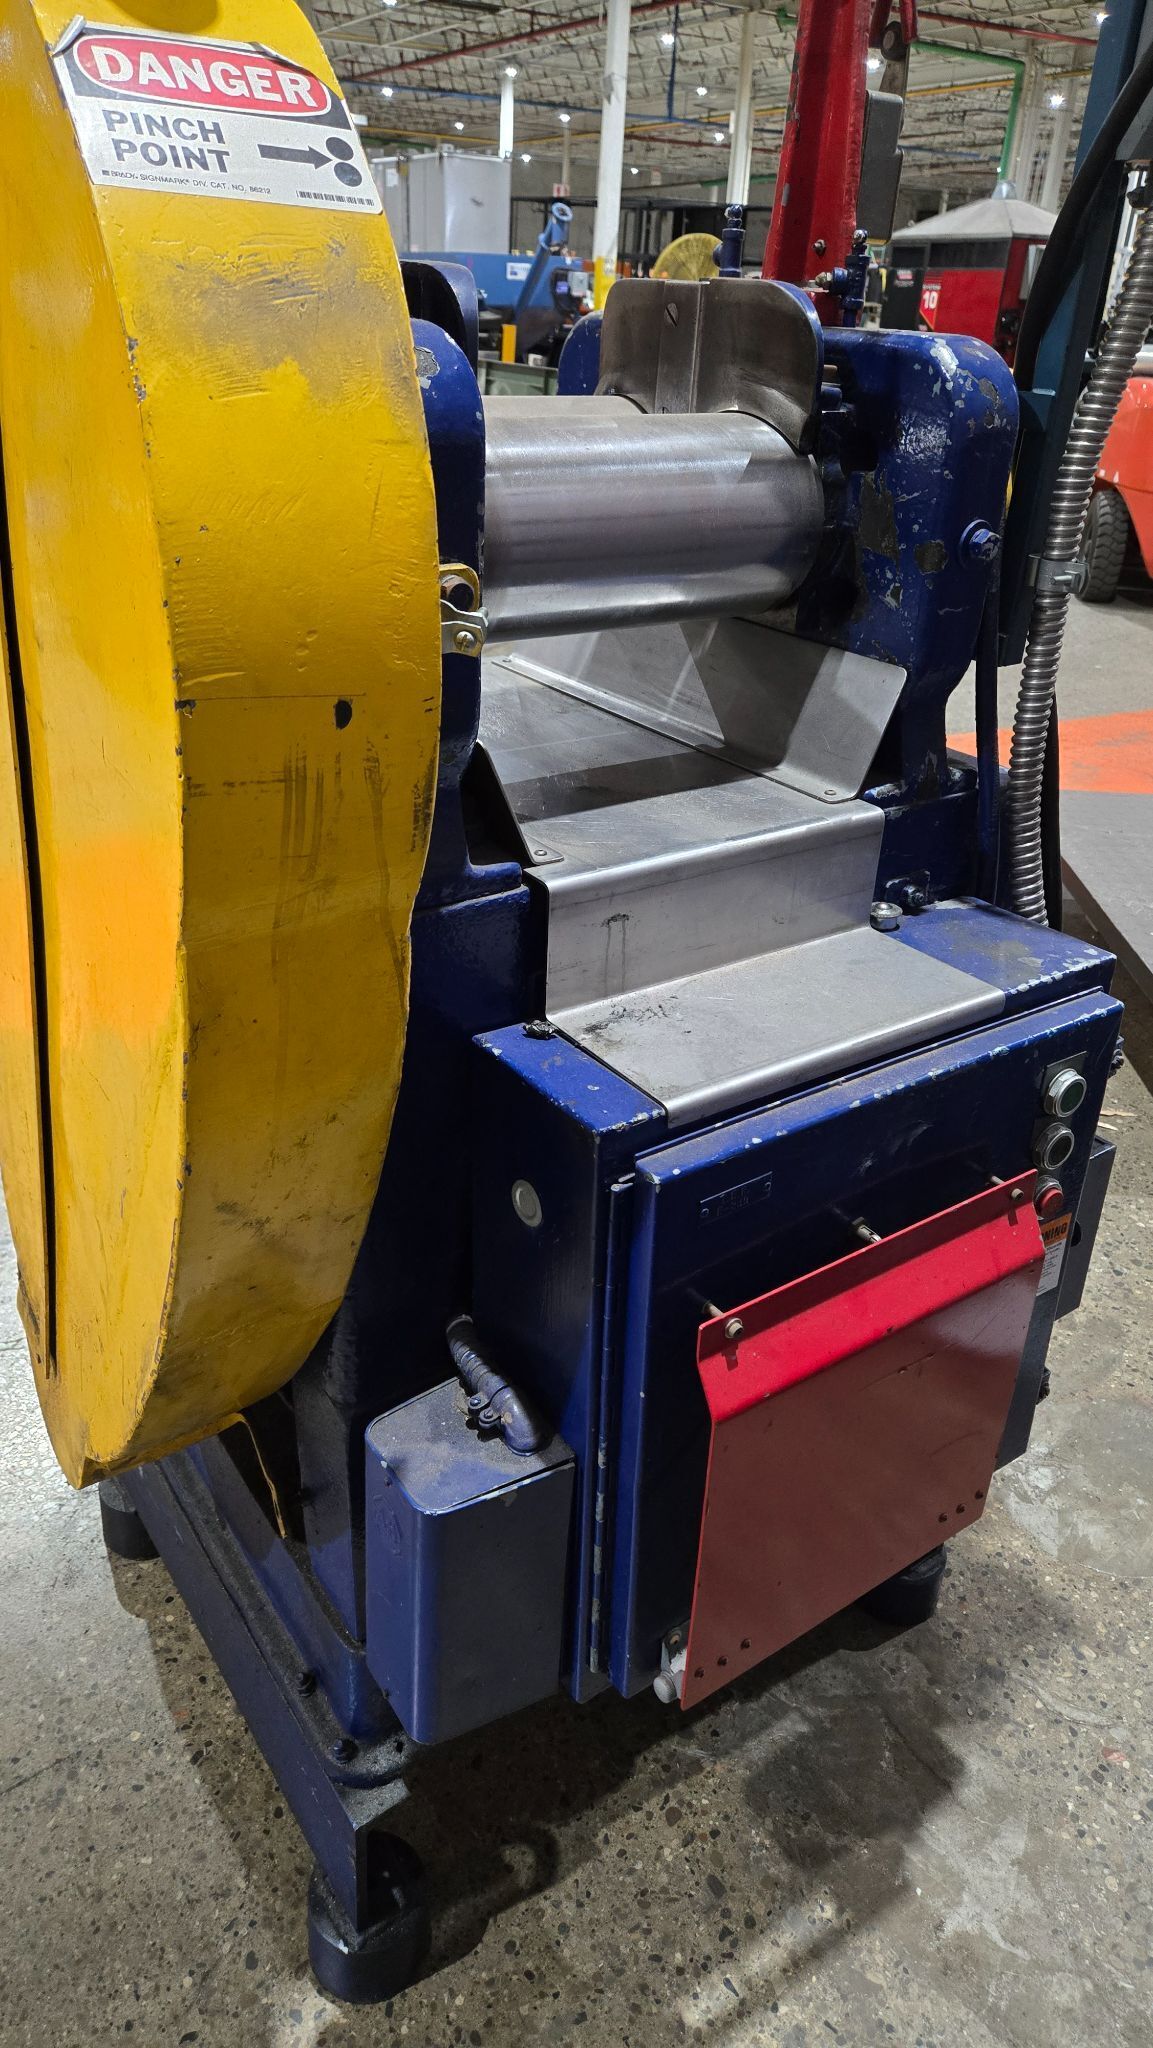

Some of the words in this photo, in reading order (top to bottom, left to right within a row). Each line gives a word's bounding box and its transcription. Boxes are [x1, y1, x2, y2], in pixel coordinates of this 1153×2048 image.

[91, 45, 318, 108] DANGER
[102, 109, 226, 145] PINCH
[111, 138, 230, 173] POINT
[922, 290, 938, 309] 10
